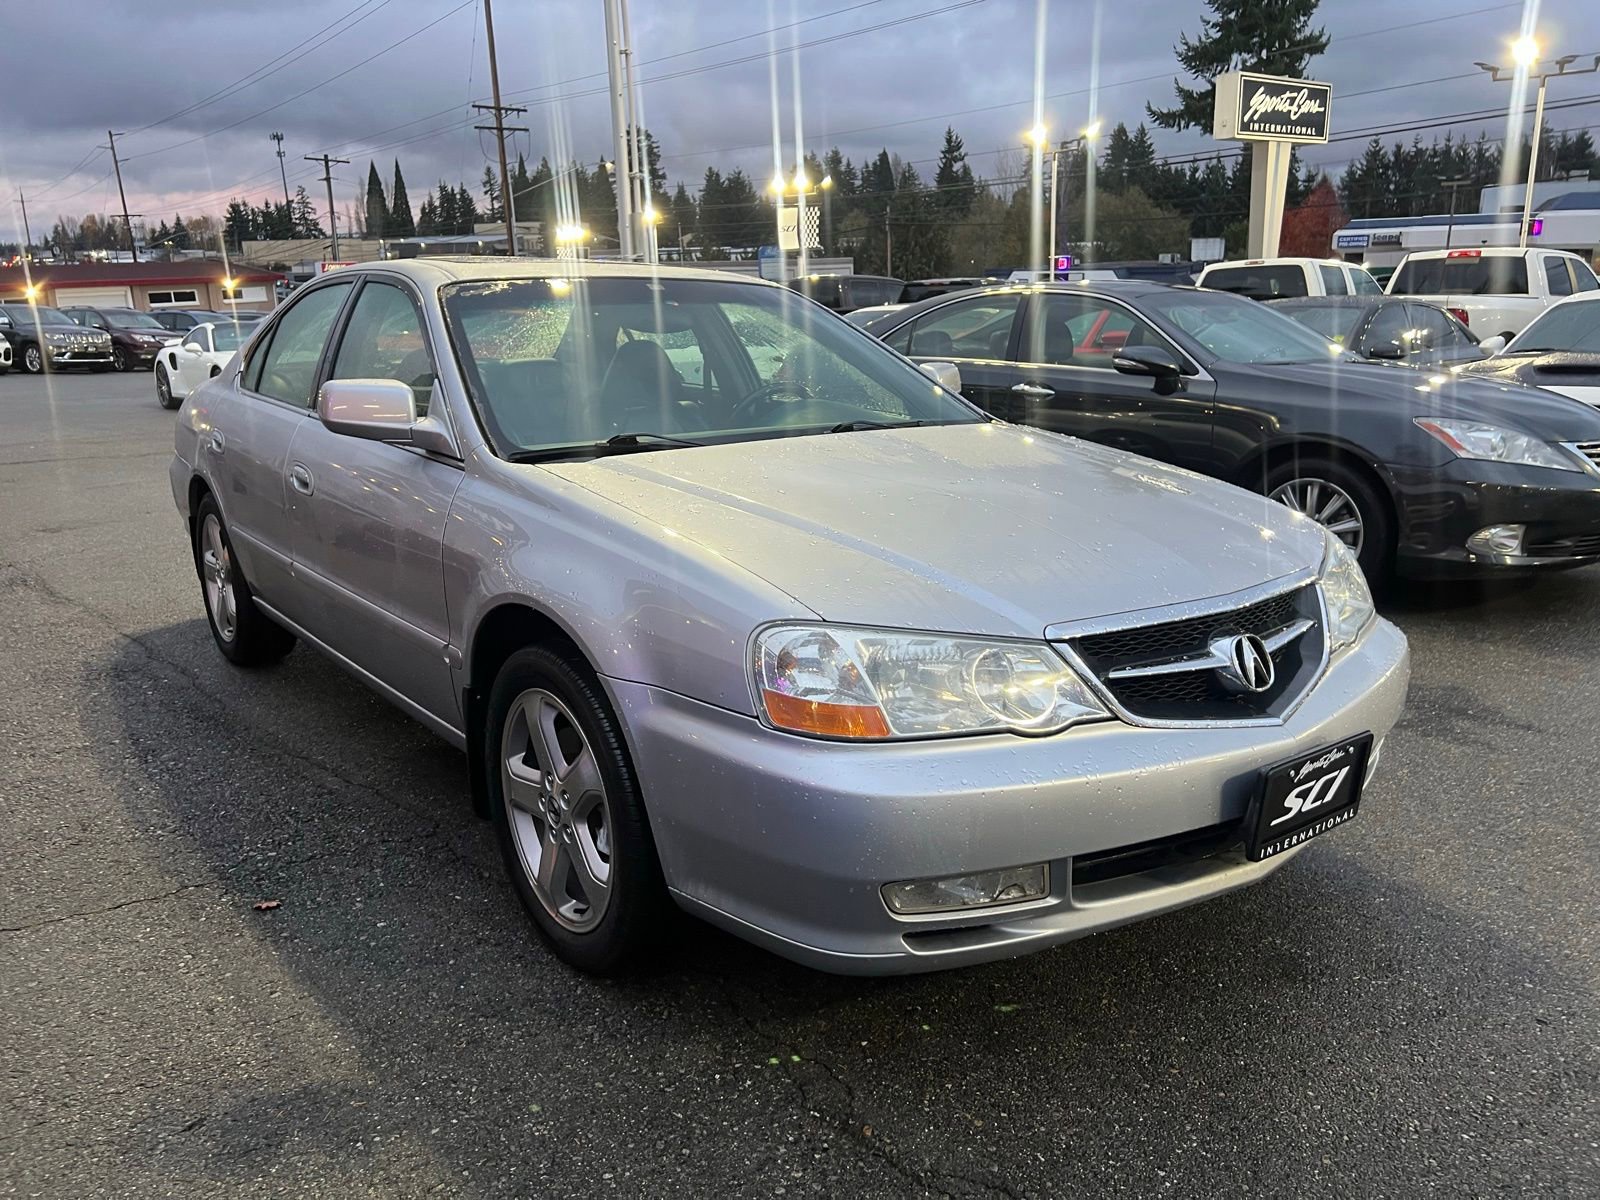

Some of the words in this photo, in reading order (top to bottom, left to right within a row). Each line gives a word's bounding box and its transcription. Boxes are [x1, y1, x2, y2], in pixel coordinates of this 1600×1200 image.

[1244, 86, 1297, 122] Sports
[1249, 123, 1316, 135] INTERNATIONAL
[1270, 766, 1350, 826] SCI
[1260, 808, 1355, 859] INTERNATIONAL
